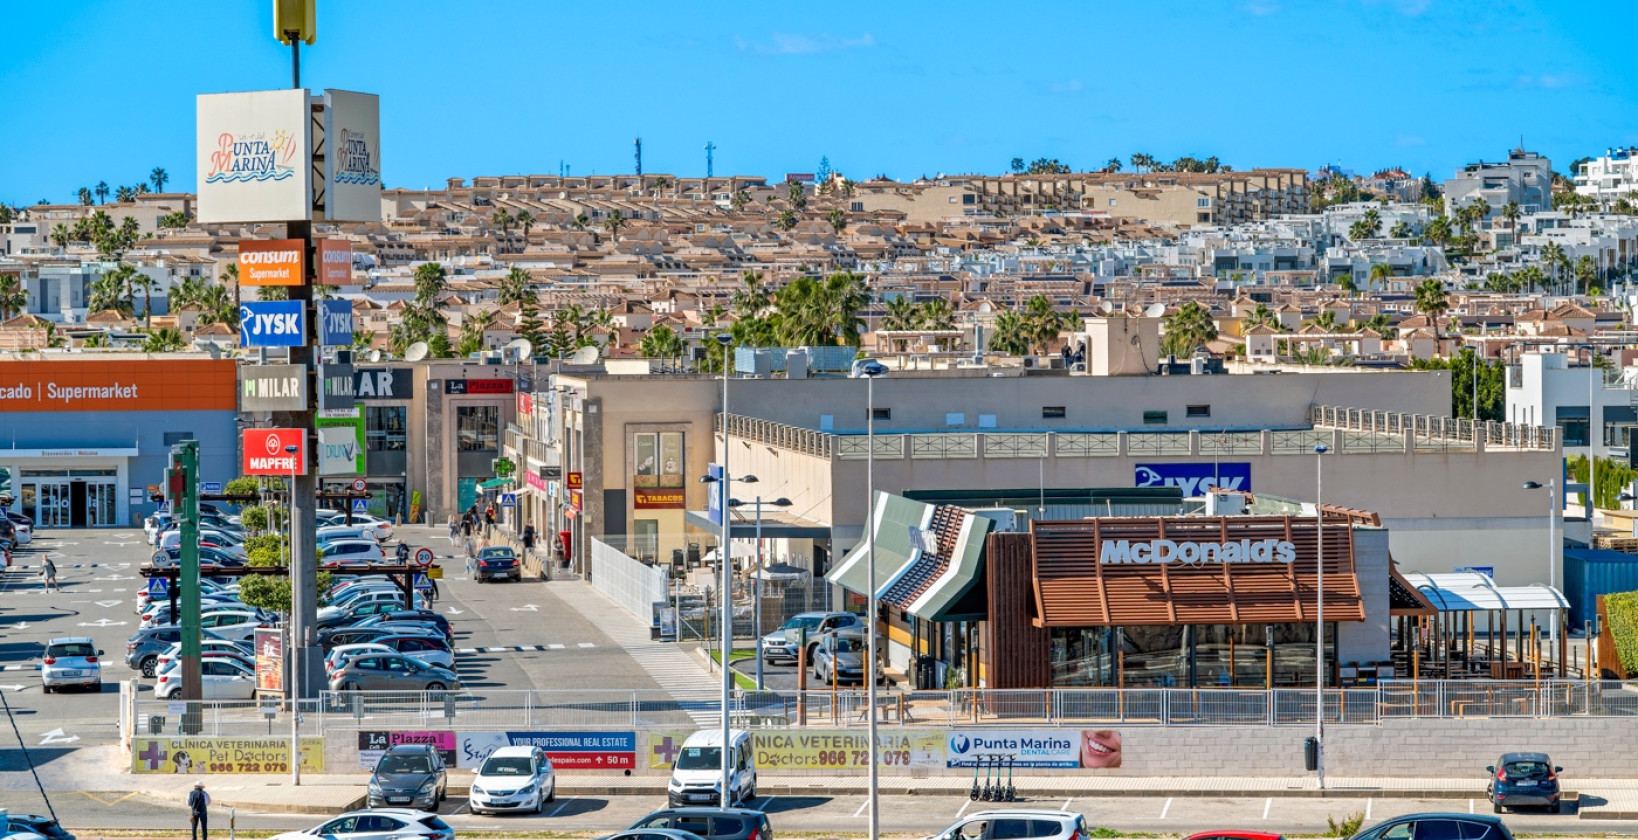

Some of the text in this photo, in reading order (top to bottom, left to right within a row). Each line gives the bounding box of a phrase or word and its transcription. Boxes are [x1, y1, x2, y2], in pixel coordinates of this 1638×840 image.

[218, 132, 270, 156] PUNTA
[341, 128, 367, 155] PUNTA
[208, 150, 276, 177] MARINA
[336, 147, 370, 177] MARINA
[240, 250, 299, 264] consum
[249, 267, 290, 281] Supermarket
[252, 313, 300, 335] JYSK
[329, 312, 352, 333] JYSK
[47, 382, 138, 403] Supermarket
[258, 376, 299, 397] MILAR
[332, 376, 352, 396] MILAR
[450, 381, 464, 390] La
[249, 456, 297, 470] MAPFRE
[646, 495, 684, 503] TABACOS
[1099, 538, 1297, 564] McDonald's
[171, 738, 287, 749] CLÍNICA VETERINARIA
[368, 732, 387, 745] La
[391, 733, 437, 744] Plazza
[512, 737, 628, 747] YOUR PROFESSIONAL REAL ESTATE
[754, 735, 795, 748] NICA
[973, 737, 1071, 749] Punta Marina
[209, 749, 229, 761] Pet
[606, 756, 619, 764] 50
[818, 751, 847, 765] 966
[883, 750, 911, 765] 079
[237, 763, 261, 773] 722
[264, 763, 288, 773] 079
